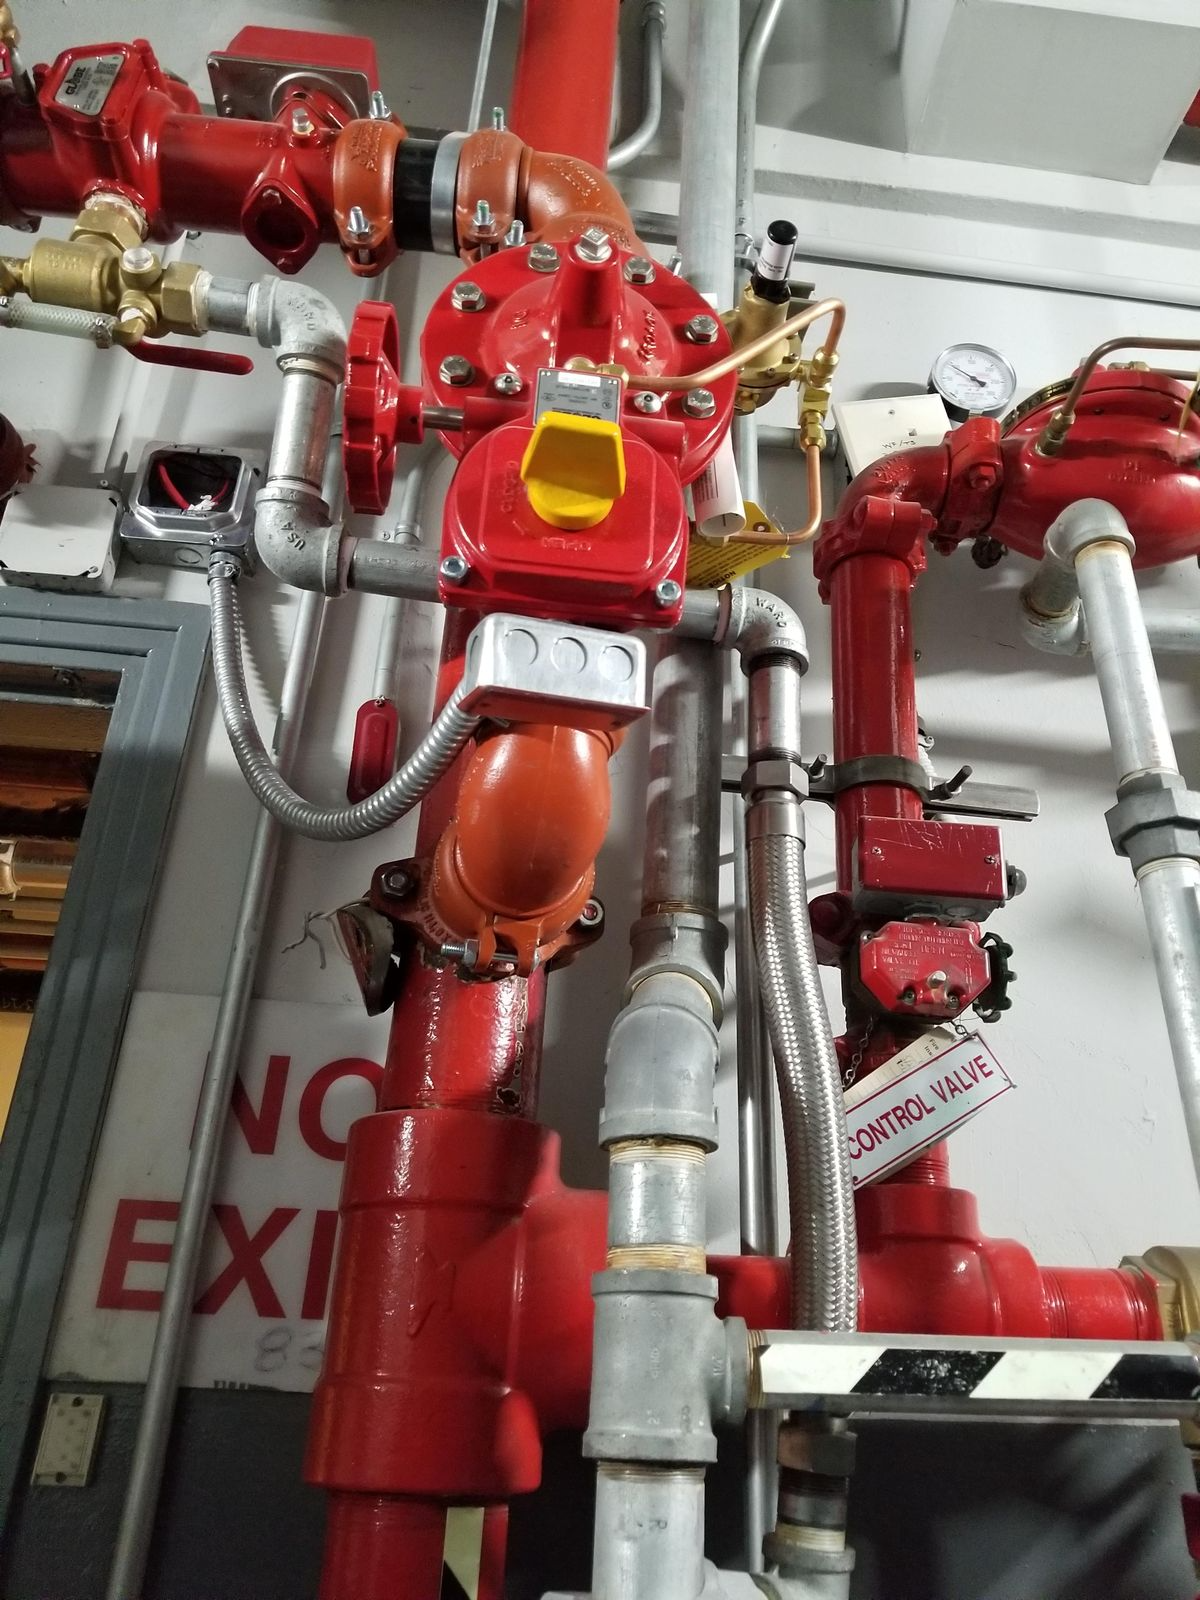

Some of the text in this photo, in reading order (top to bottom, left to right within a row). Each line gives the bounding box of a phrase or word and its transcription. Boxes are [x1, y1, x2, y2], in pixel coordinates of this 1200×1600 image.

[190, 1054, 385, 1161] NO
[849, 1054, 995, 1161] CONTROL VALVE
[95, 1198, 339, 1320] EXI
